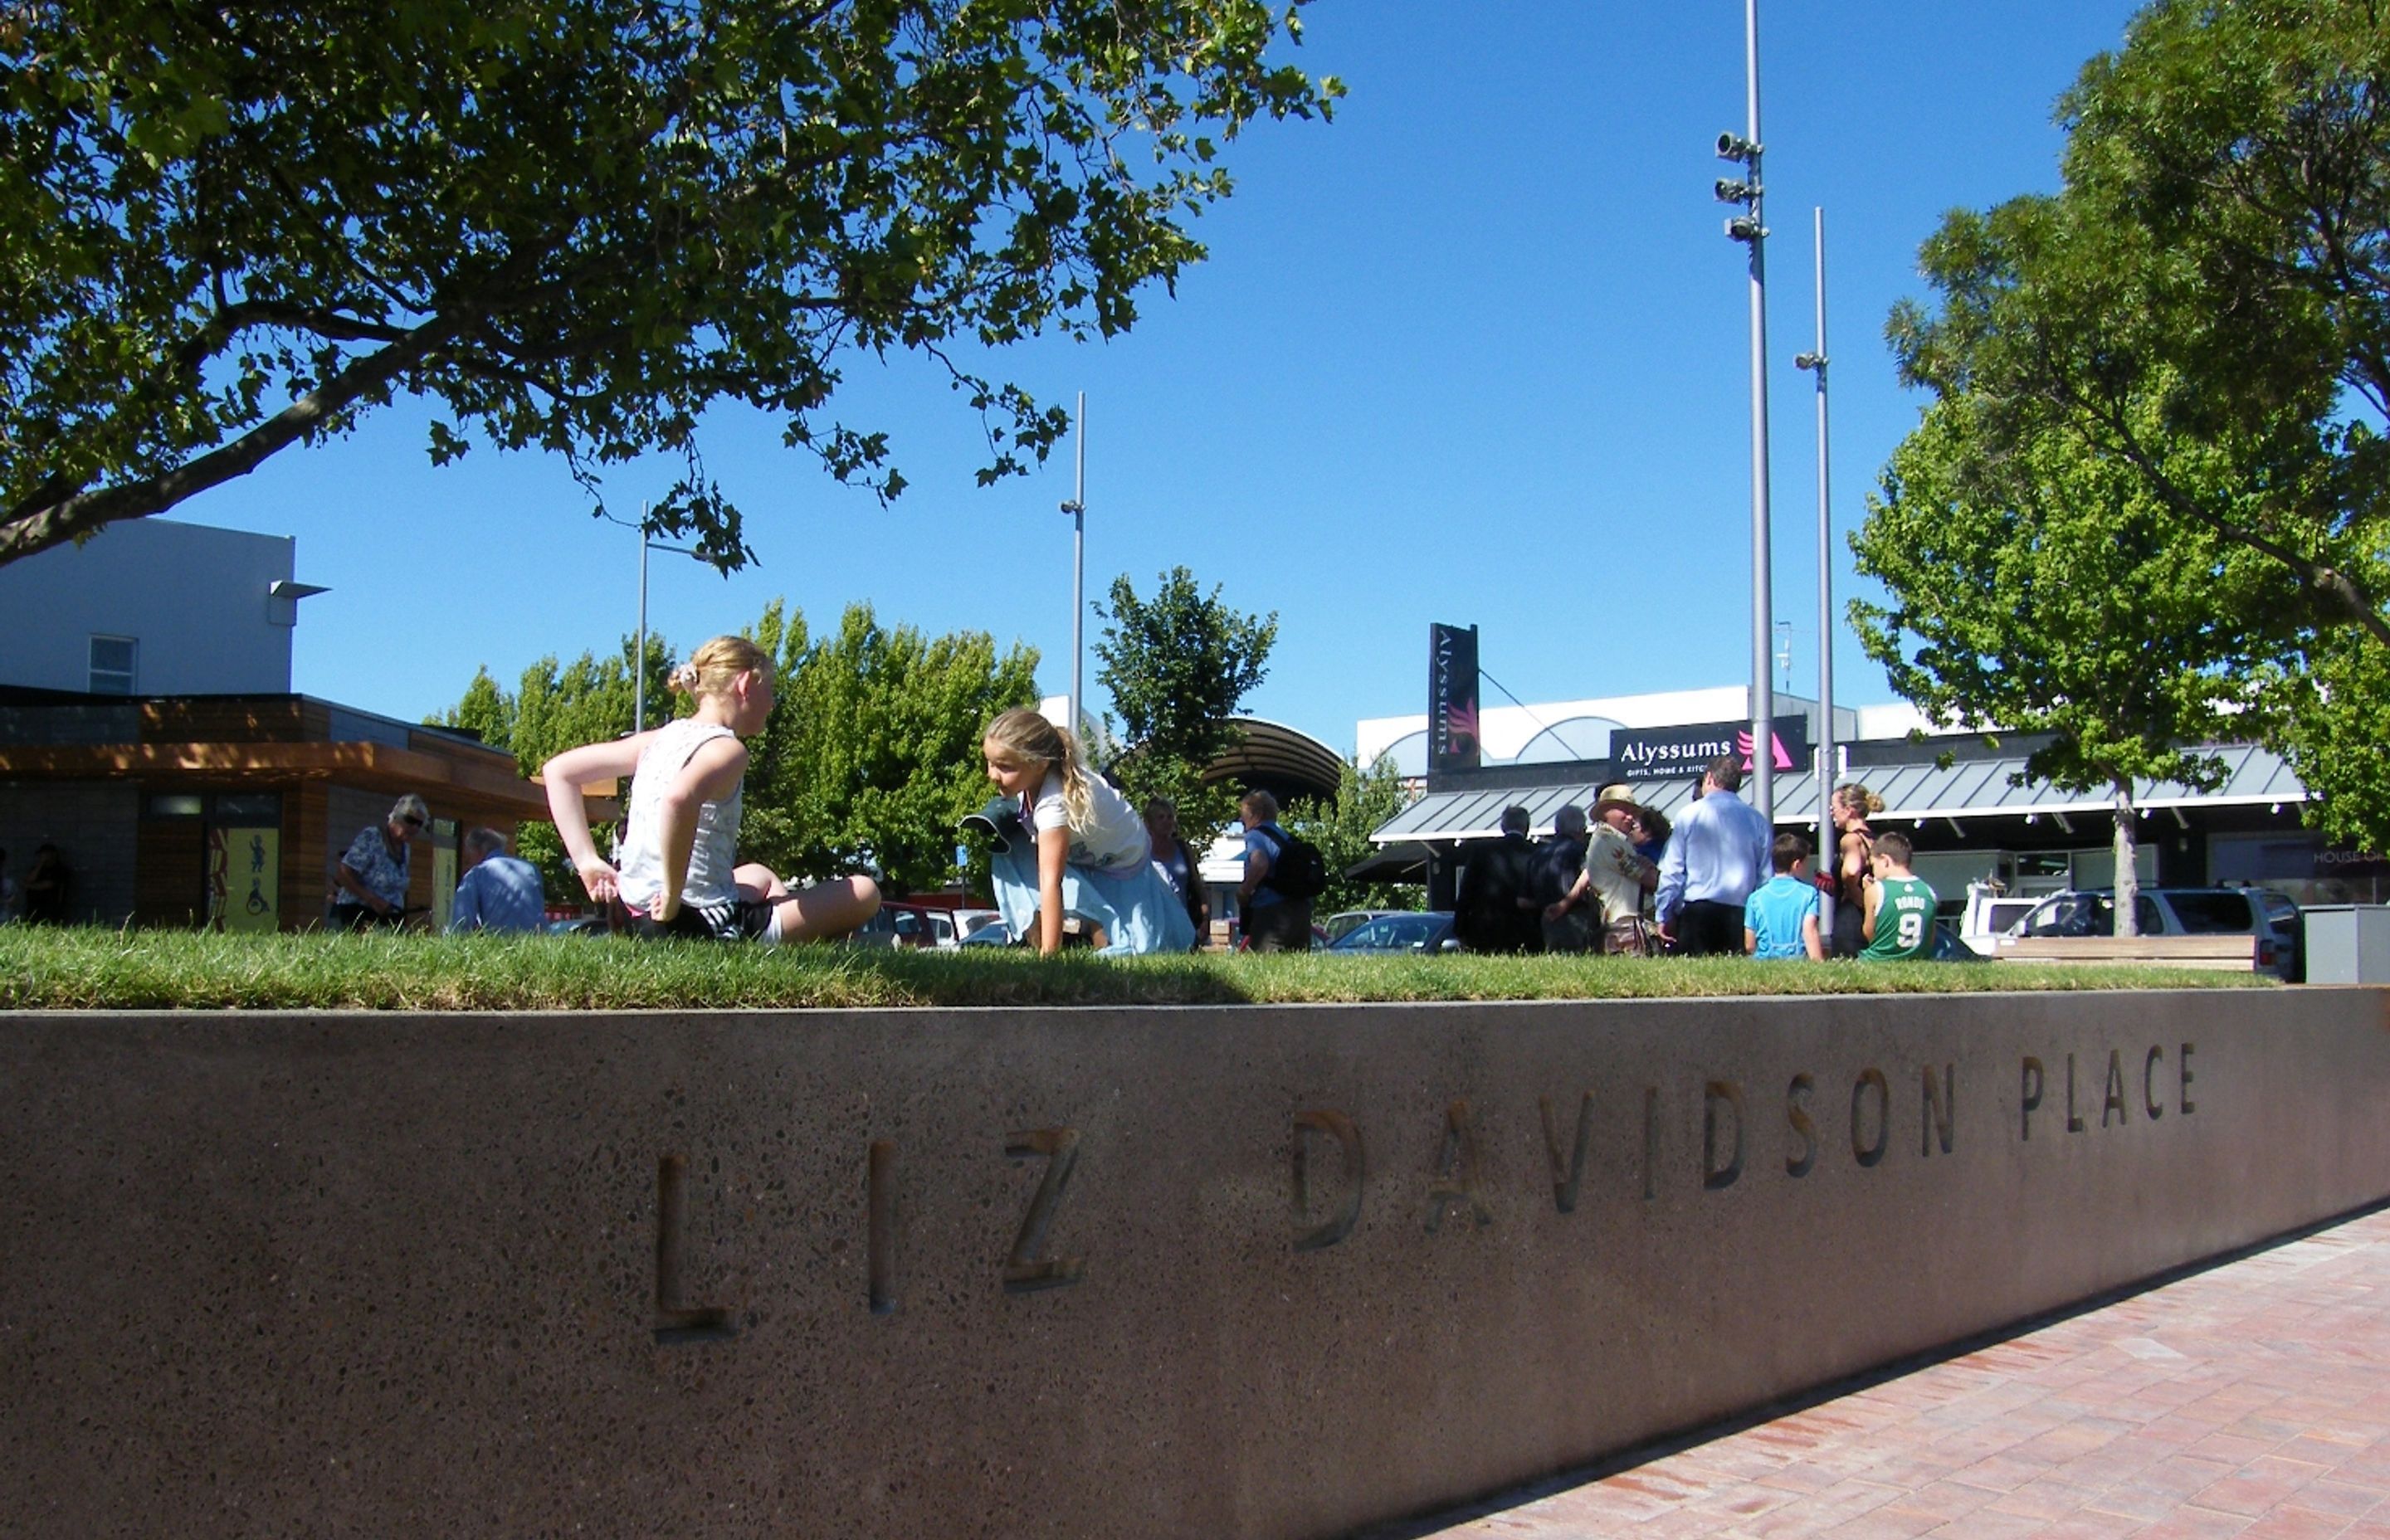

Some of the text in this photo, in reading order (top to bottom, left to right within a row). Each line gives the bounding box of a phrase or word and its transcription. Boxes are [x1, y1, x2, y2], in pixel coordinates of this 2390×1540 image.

[1436, 630, 1452, 755] Alyssums
[1621, 741, 1731, 765] Alyssums
[2314, 850, 2360, 863] HOUSE
[1897, 914, 1922, 948] 9
[652, 1042, 2196, 1347] LIZ DAVIDSON PLACE
